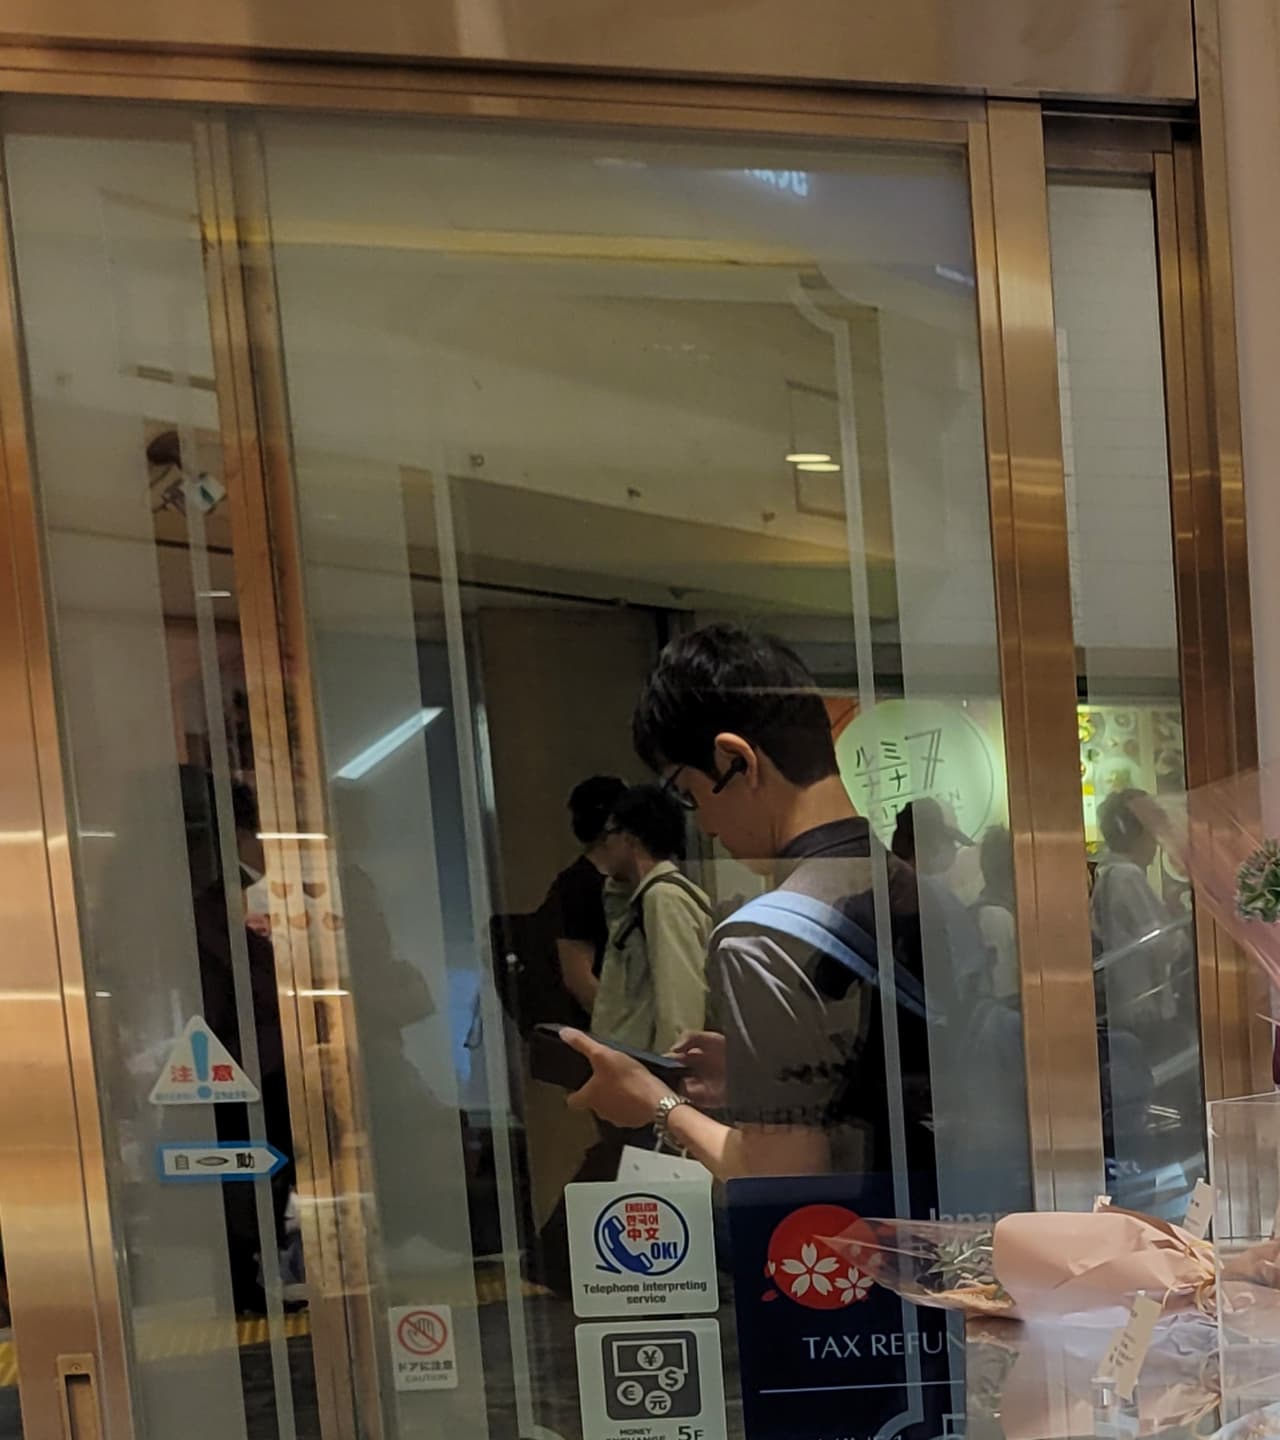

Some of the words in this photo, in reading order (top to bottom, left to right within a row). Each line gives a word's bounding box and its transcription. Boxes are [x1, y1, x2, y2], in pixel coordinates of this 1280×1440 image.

[626, 1214, 659, 1227] 한국어
[626, 1226, 660, 1242] 中文
[583, 1282, 640, 1295] Telephone
[642, 1280, 708, 1293] interpreting
[626, 1294, 667, 1305] service
[801, 1334, 862, 1360] TAX
[870, 1329, 965, 1358] REFUN
[619, 1428, 653, 1436] MONEY
